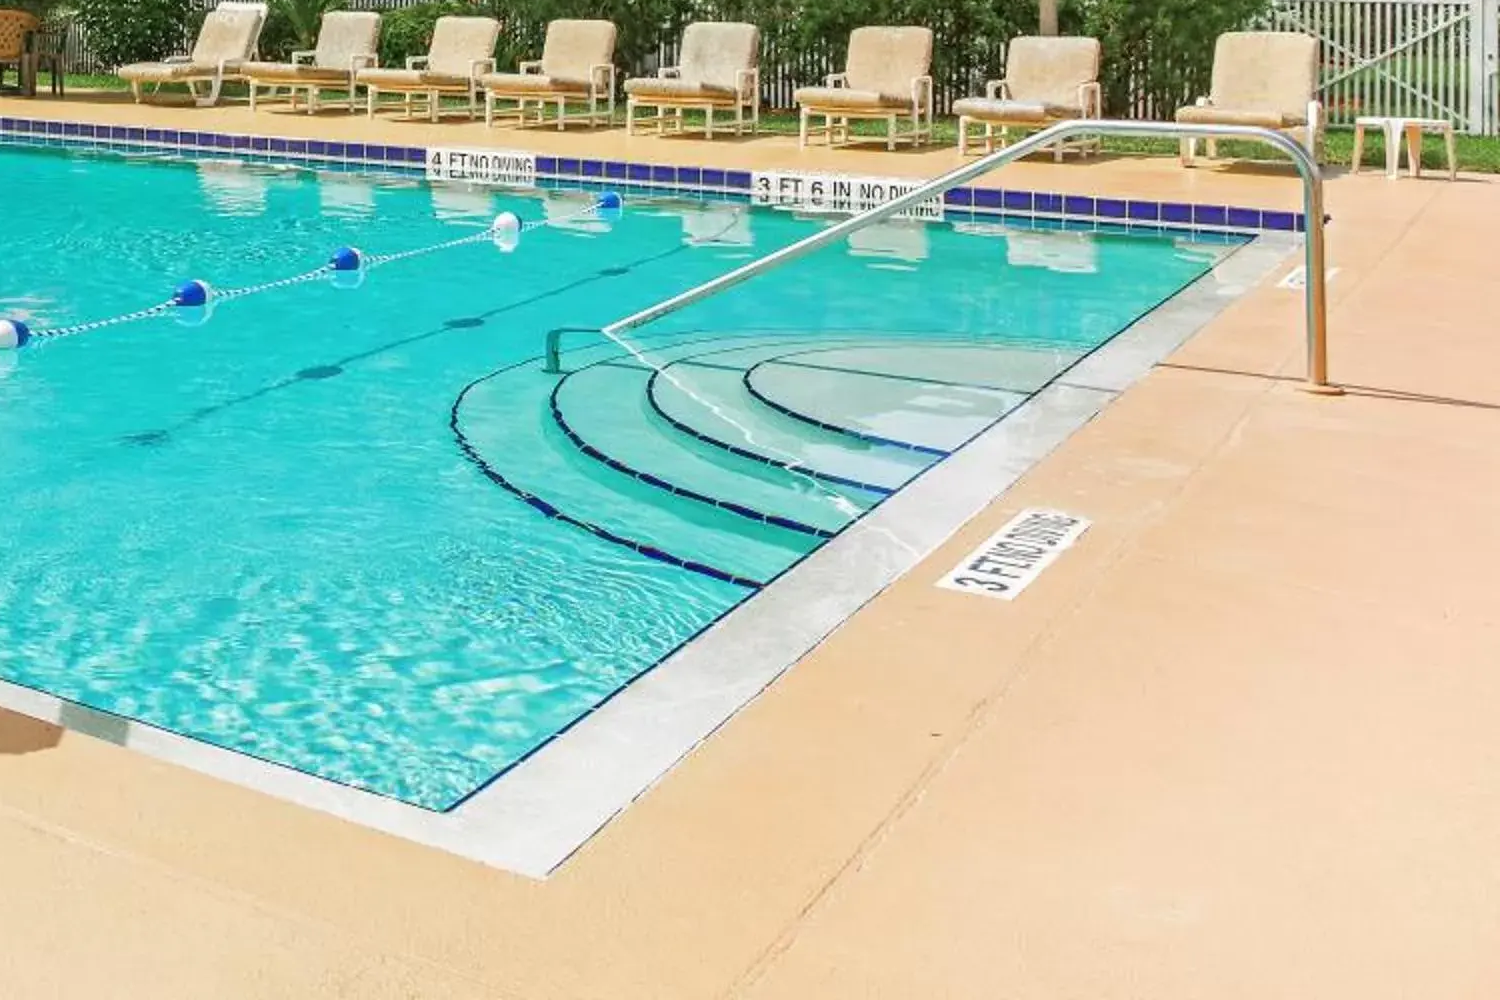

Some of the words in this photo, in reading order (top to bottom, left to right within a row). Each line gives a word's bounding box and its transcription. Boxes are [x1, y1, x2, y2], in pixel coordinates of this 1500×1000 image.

[431, 152, 442, 166] 4
[449, 152, 468, 168] FT
[469, 154, 489, 170] NO
[491, 155, 534, 173] DIVING
[757, 177, 771, 195] 3
[779, 177, 804, 196] FT
[811, 180, 824, 198] 6
[832, 181, 851, 199] IN
[859, 183, 884, 201] NO
[968, 554, 1034, 579] FT
[954, 577, 1010, 592] 3
